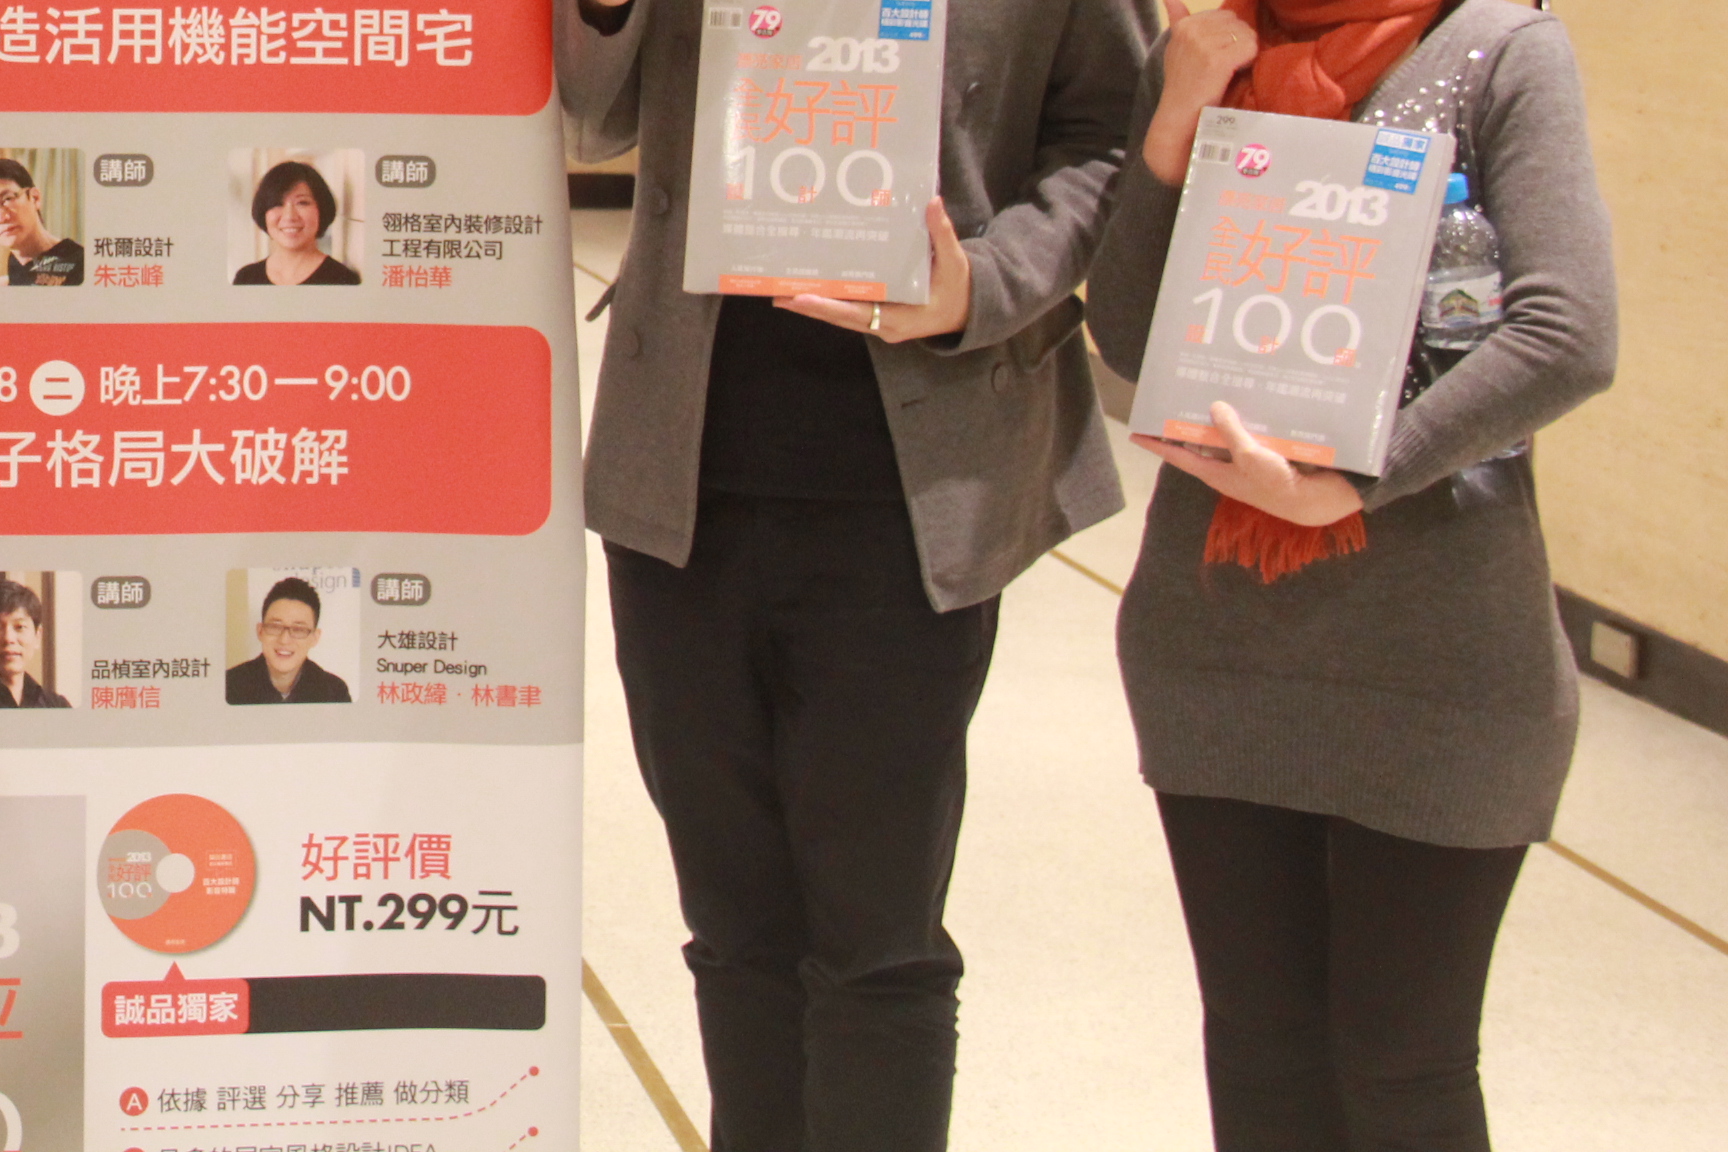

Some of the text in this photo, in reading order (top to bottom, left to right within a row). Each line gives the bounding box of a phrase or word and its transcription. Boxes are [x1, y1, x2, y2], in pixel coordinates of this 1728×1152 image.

[751, 9, 781, 30] 79
[805, 36, 901, 73] 2013
[1237, 147, 1270, 169] 79
[99, 159, 147, 183] 講師
[382, 160, 429, 184] 講師
[1289, 180, 1390, 226] 2013
[94, 237, 174, 258] 玳爾設計
[382, 238, 503, 260] 工程有限公司
[94, 264, 164, 288] 朱志峰
[382, 265, 452, 288] 潘怡華
[1192, 287, 1362, 366] 100
[97, 581, 144, 605] 講師
[377, 578, 423, 601] 講師
[378, 630, 458, 651] 大雄設計
[377, 659, 487, 677] Snuper Design
[300, 833, 452, 883] 好評價
[114, 990, 239, 1028] 誠品獨家
[157, 1088, 207, 1113] 依據
[217, 1085, 267, 1111] 評選
[275, 1083, 326, 1108] 分享
[335, 1081, 384, 1107] 推薦
[394, 1079, 469, 1105] 做分類
